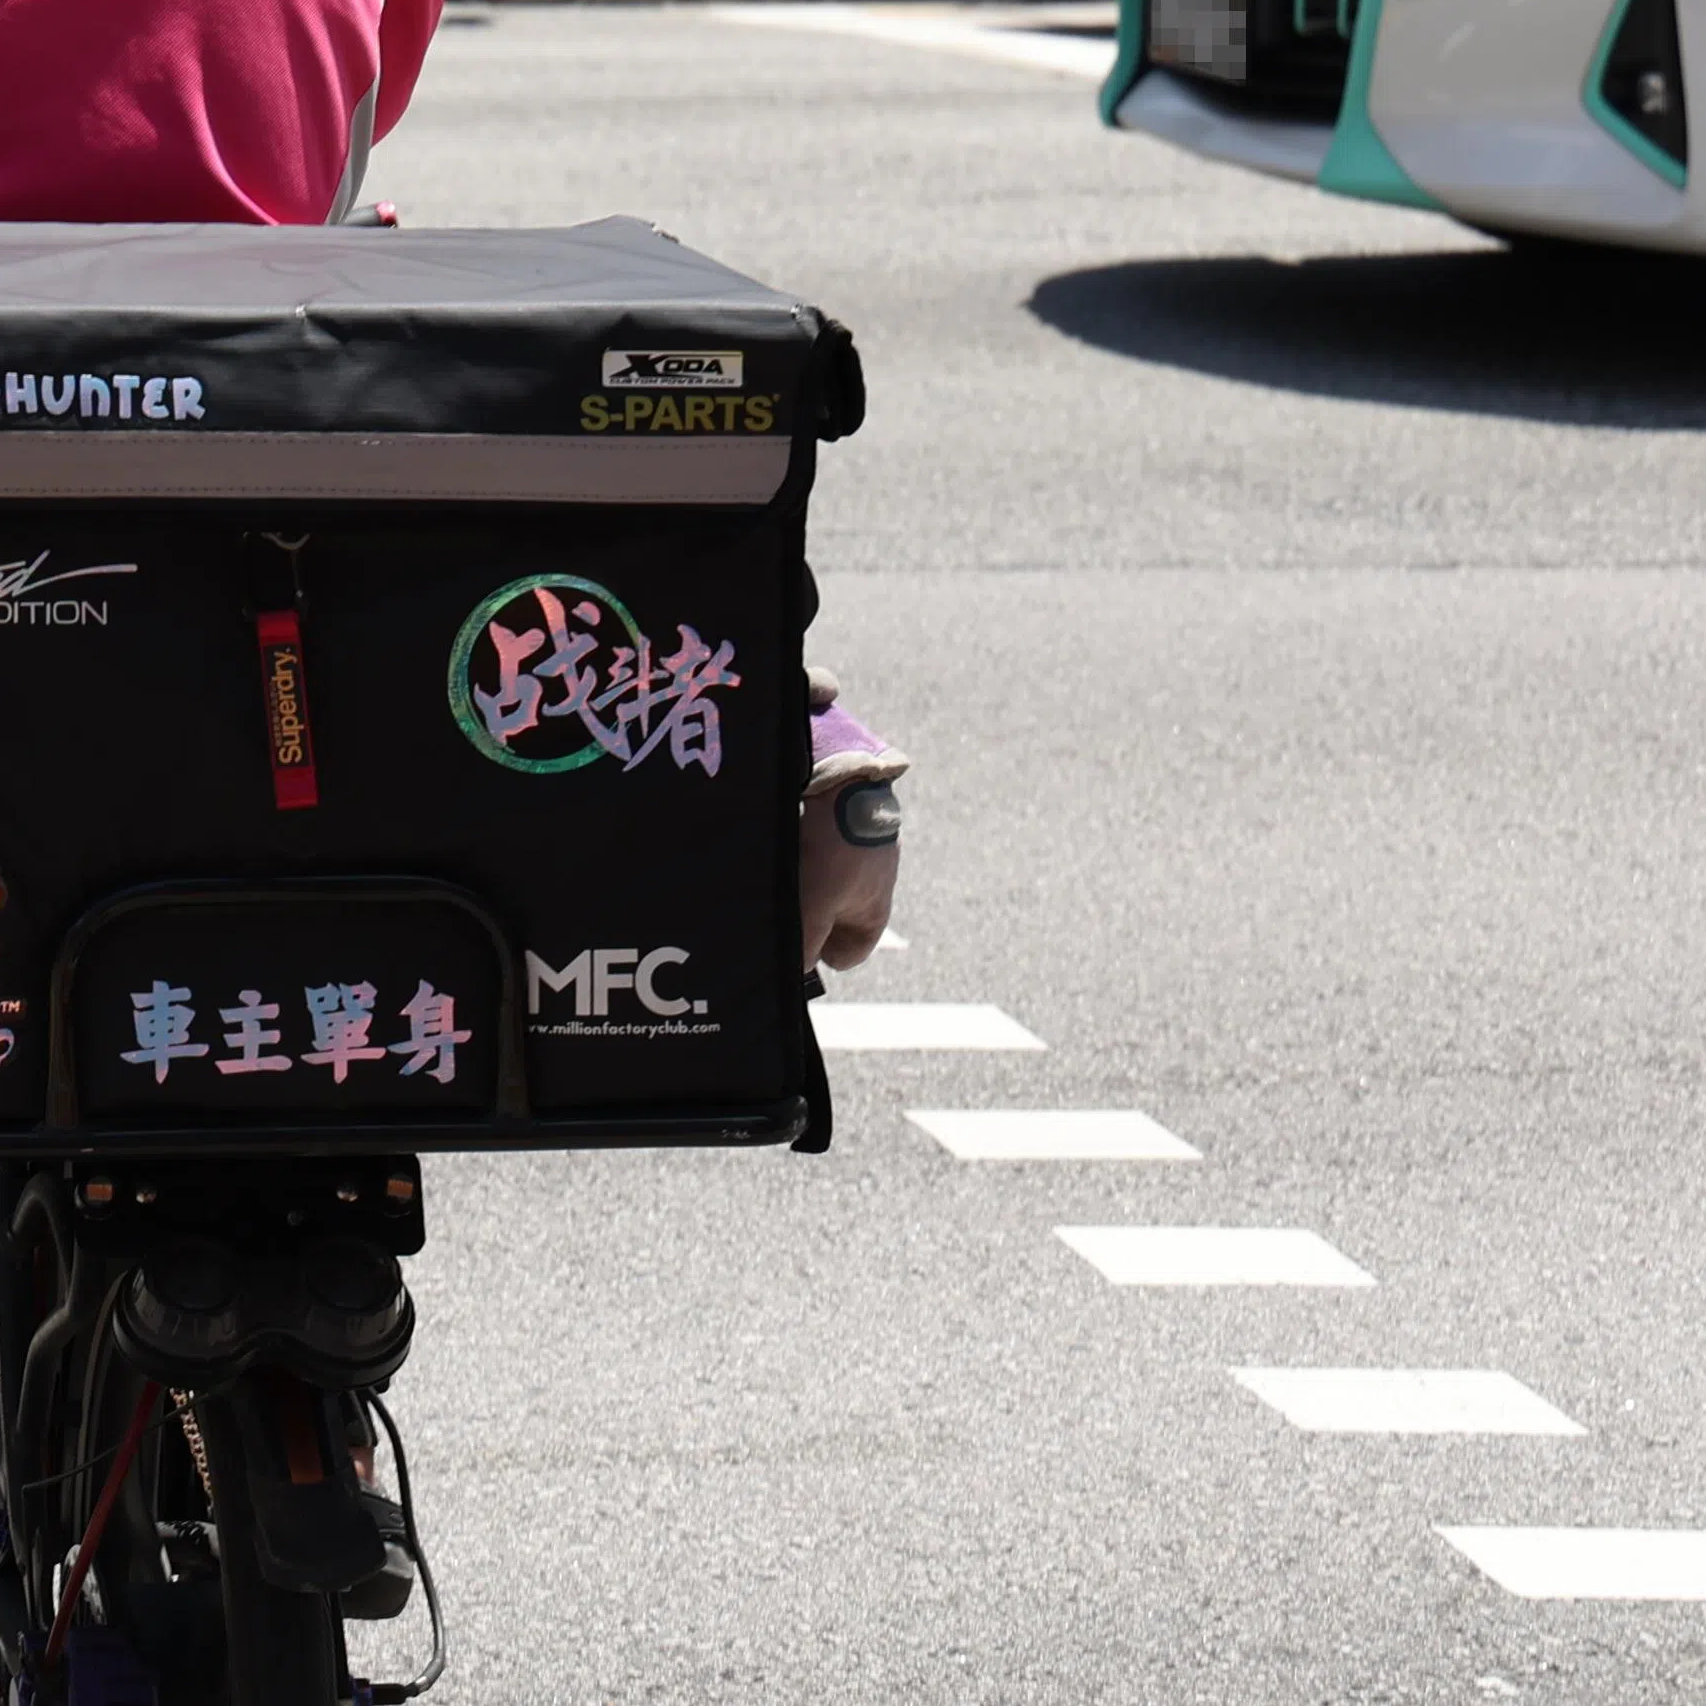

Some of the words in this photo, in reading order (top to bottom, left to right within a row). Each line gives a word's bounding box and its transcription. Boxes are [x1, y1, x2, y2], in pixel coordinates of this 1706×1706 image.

[609, 354, 724, 378] XODA
[524, 946, 709, 1017] MFC.
[118, 979, 474, 1086] 車主單身
